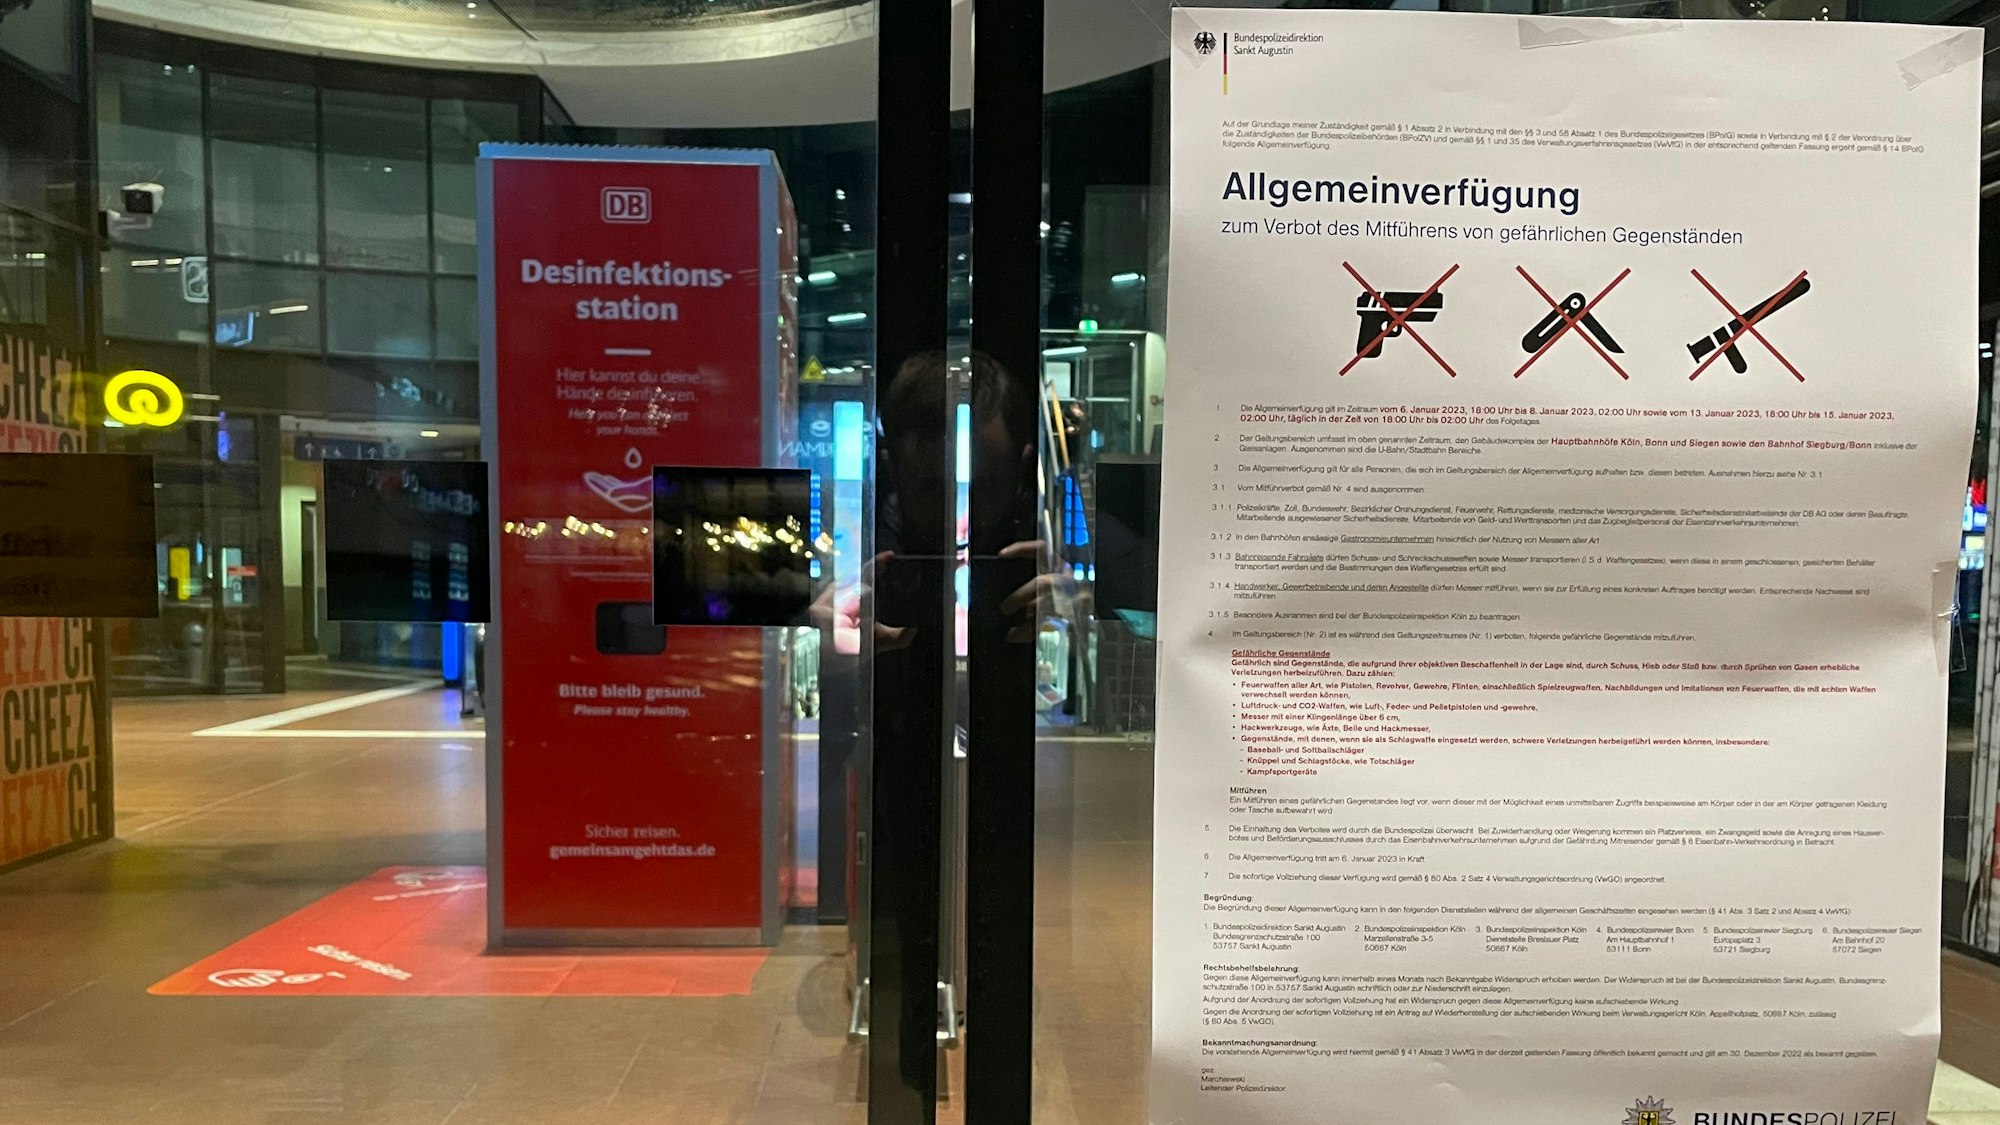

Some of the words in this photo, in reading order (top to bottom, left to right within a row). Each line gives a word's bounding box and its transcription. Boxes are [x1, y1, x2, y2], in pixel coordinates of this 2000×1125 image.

[1234, 33, 1323, 44] Bundespolizeidirektion
[1234, 45, 1255, 55] Sankt
[1258, 45, 1293, 57] Augustin
[1222, 171, 1581, 216] Allgemeinverfügung
[608, 193, 644, 217] DB
[1222, 221, 1257, 234] zum
[1264, 218, 1321, 235] Verbot
[1328, 220, 1359, 236] des
[1367, 220, 1457, 239] Mitführens
[1463, 227, 1493, 239] von
[1500, 224, 1605, 245] gefährlichen
[1613, 226, 1742, 248] Gegenständen
[521, 258, 733, 287] Desinfektions-
[576, 294, 678, 321] station
[556, 367, 586, 382] Hier
[589, 368, 634, 383] kannst
[638, 369, 658, 383] du
[661, 370, 701, 384] deine
[1254, 404, 1323, 414] Allgemeinverfügung
[1380, 406, 1398, 414] vom
[1410, 406, 1439, 414] Januar
[1442, 405, 1467, 414] 2023,
[1471, 405, 1495, 415] 18:00
[1498, 407, 1513, 415] Uhr
[1515, 407, 1527, 415] bis
[1540, 408, 1568, 416] Januar
[1571, 408, 1596, 416] 2023,
[1598, 408, 1624, 416] 02:00
[1626, 408, 1641, 417] Uhr
[1705, 410, 1734, 418] Januar
[1737, 410, 1761, 418] 2023,
[1766, 410, 1789, 418] 18:00
[1792, 410, 1806, 418] Uhr
[1809, 410, 1820, 419] bis
[1869, 411, 1894, 420] 2023,
[1241, 414, 1266, 422] 02:00
[1269, 414, 1285, 423] Uhr,
[1288, 414, 1316, 424] täglich
[1319, 414, 1326, 423] in
[1329, 415, 1343, 423] der
[1345, 414, 1361, 423] Zeit
[1364, 416, 1378, 424] von
[1383, 415, 1407, 424] 18:00
[1409, 415, 1424, 424] Uhr
[1427, 416, 1438, 424] bis
[1441, 415, 1467, 425] 02:00
[1469, 417, 1484, 425] Uhr
[1551, 437, 1618, 446] Hauptbahnhöfe
[1645, 438, 1668, 446] Bonn
[1689, 439, 1719, 449] Siegen
[1749, 440, 1765, 448] den
[1768, 440, 1804, 448] Bahnhof
[1807, 440, 1872, 450] Siegburg/Bonn
[1232, 649, 1276, 659] Gefährliche
[1277, 650, 1330, 659] Gegenstände
[1231, 668, 1282, 677] Verletzungen
[1284, 669, 1343, 677] herbeizuführen.
[559, 683, 599, 699] Bitte
[602, 684, 642, 699] bleib
[646, 685, 706, 701] gesund.
[573, 704, 613, 717] Please
[616, 706, 642, 718] stay
[644, 705, 691, 718] healthy.
[1282, 702, 1297, 710] und
[1386, 702, 1411, 710] Feder-
[1413, 703, 1427, 711] und
[1501, 704, 1537, 712] -gewehre,
[1307, 713, 1357, 722] Klingenlänge
[1359, 713, 1377, 721] über
[1379, 713, 1384, 721] 6
[1241, 724, 1304, 733] Hackwerkzeuge,
[1322, 724, 1341, 732] Äxte,
[1248, 746, 1283, 754] Baseball-
[1302, 746, 1364, 755] Softballschläger
[1247, 757, 1279, 765] Knüppel
[1298, 757, 1352, 766] Schlagstöcke,
[1370, 757, 1414, 766] Totschläger
[1247, 768, 1317, 776] Kampfsportgeräte
[1230, 786, 1267, 794] Mitführen
[585, 824, 629, 839] Sicher
[633, 825, 681, 840] reisen.
[550, 843, 717, 860] gemeinsamgehtdas.de
[1243, 854, 1313, 864] Allgemeinverfügung
[1378, 854, 1397, 863] 2023
[1399, 855, 1405, 863] in
[1203, 1039, 1317, 1047] Bekanntmachungsanordnung:
